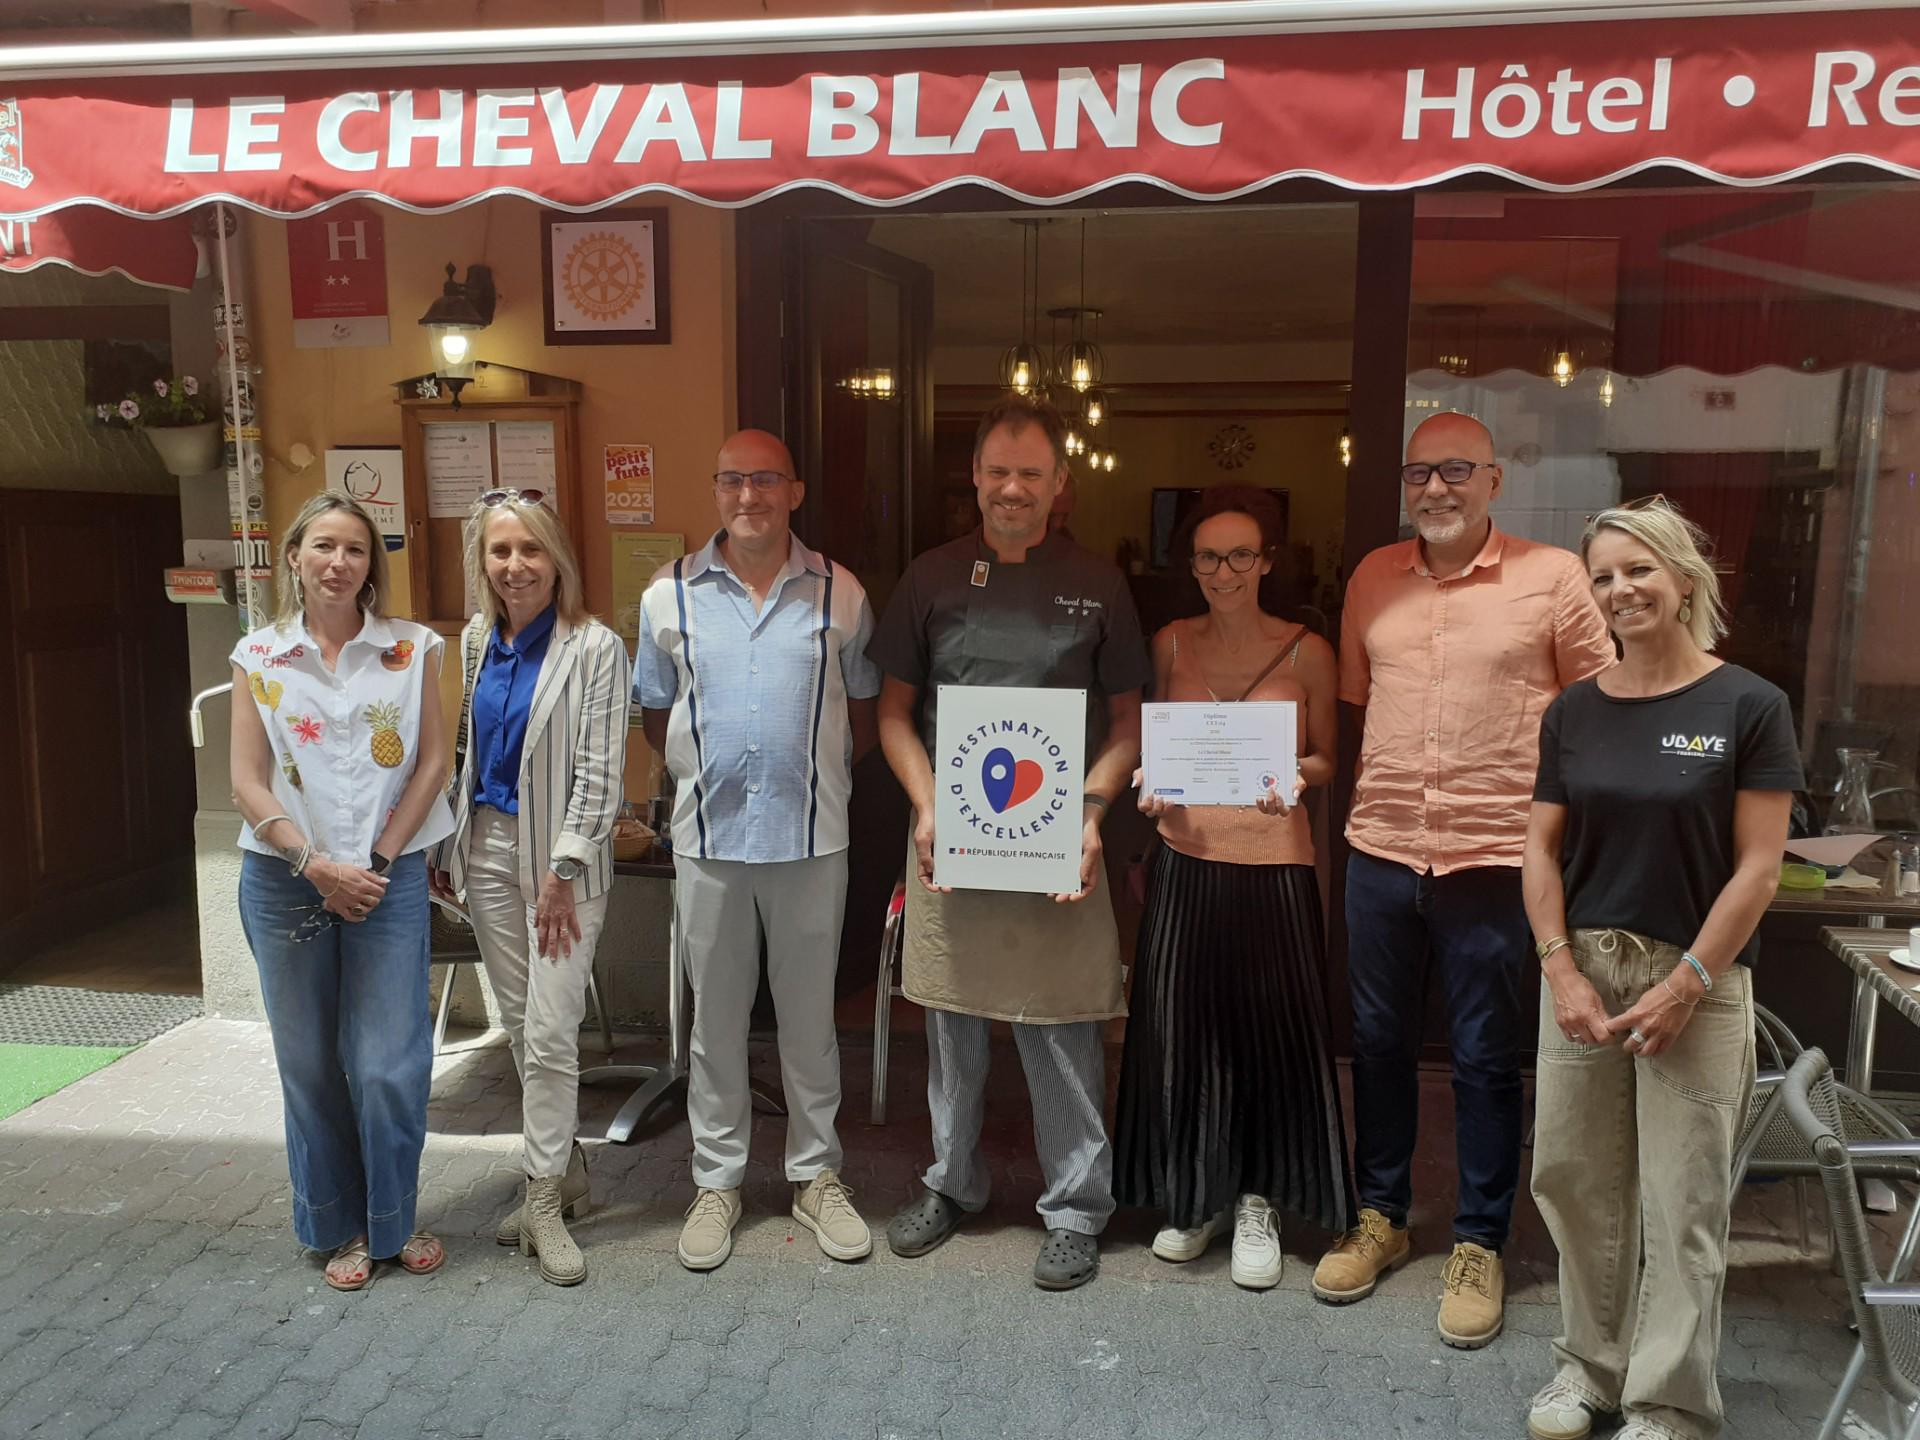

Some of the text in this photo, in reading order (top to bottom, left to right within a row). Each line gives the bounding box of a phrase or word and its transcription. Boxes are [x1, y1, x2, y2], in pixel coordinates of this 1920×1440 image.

[1402, 58, 1672, 140] Hôtel
[164, 57, 1226, 173] LE CHEVAL BLANC
[323, 219, 371, 261] H
[606, 450, 647, 471] petit
[615, 463, 650, 481] futé
[607, 492, 652, 508] 2023
[1054, 595, 1080, 607] Cheval
[951, 720, 1069, 773] DESTINATION
[1662, 734, 1727, 752] UBAYE
[951, 783, 1068, 839] D'EXCELLENCE
[966, 847, 1066, 861] RÉPUBLIQUE FRANÇAISE
